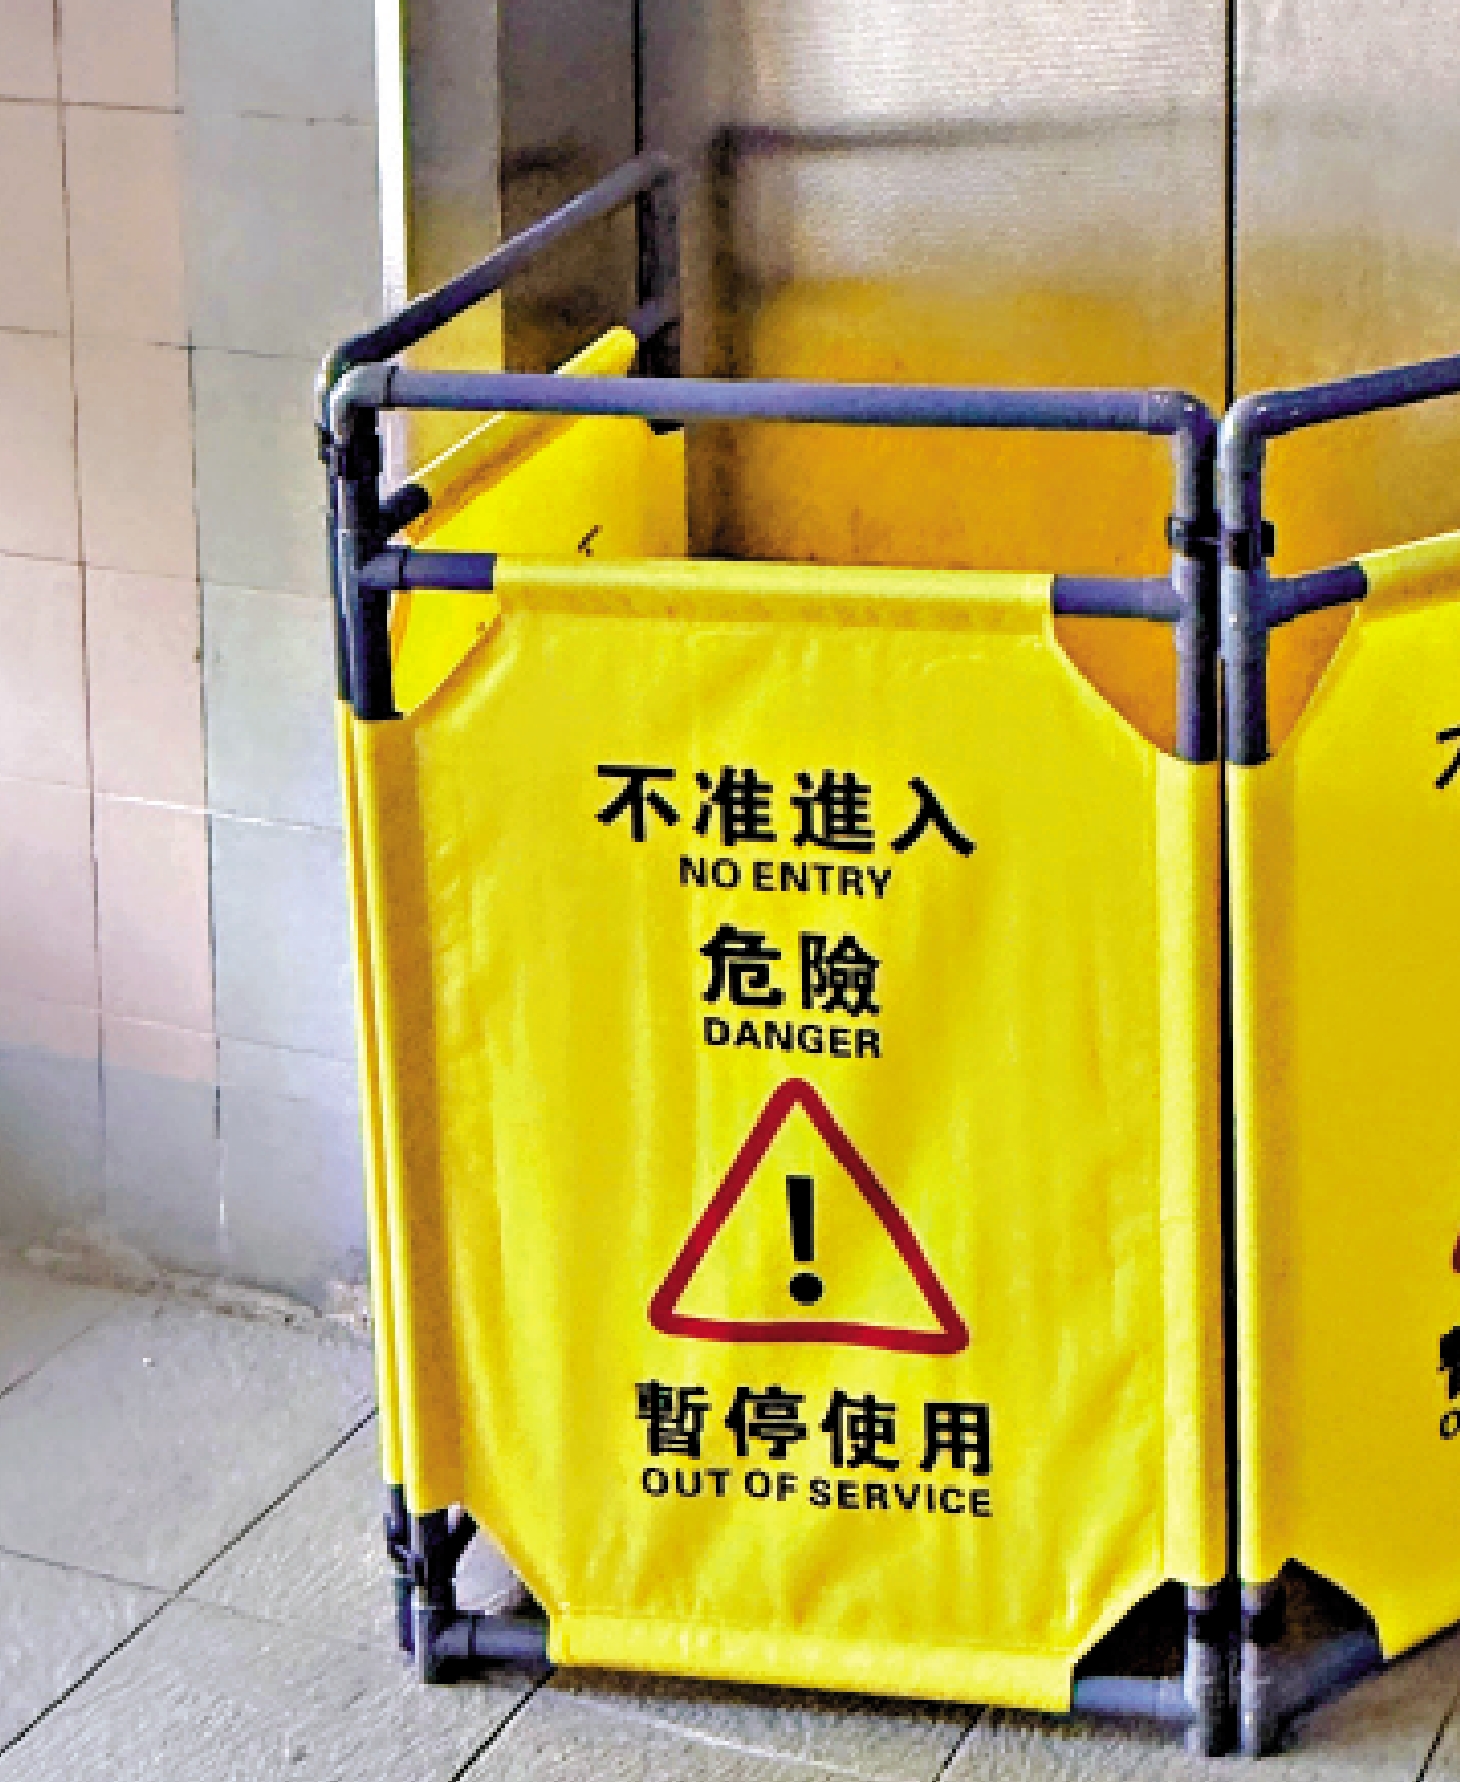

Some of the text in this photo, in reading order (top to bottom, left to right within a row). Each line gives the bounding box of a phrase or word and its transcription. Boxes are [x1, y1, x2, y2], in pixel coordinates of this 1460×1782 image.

[597, 764, 974, 858] 不准進入
[680, 857, 892, 900] NO ENTRY
[699, 922, 881, 1016] 危險
[703, 1017, 881, 1059] DANGER
[634, 1378, 992, 1475] 暫停使用
[641, 1467, 994, 1518] OUT OF SERVICE
